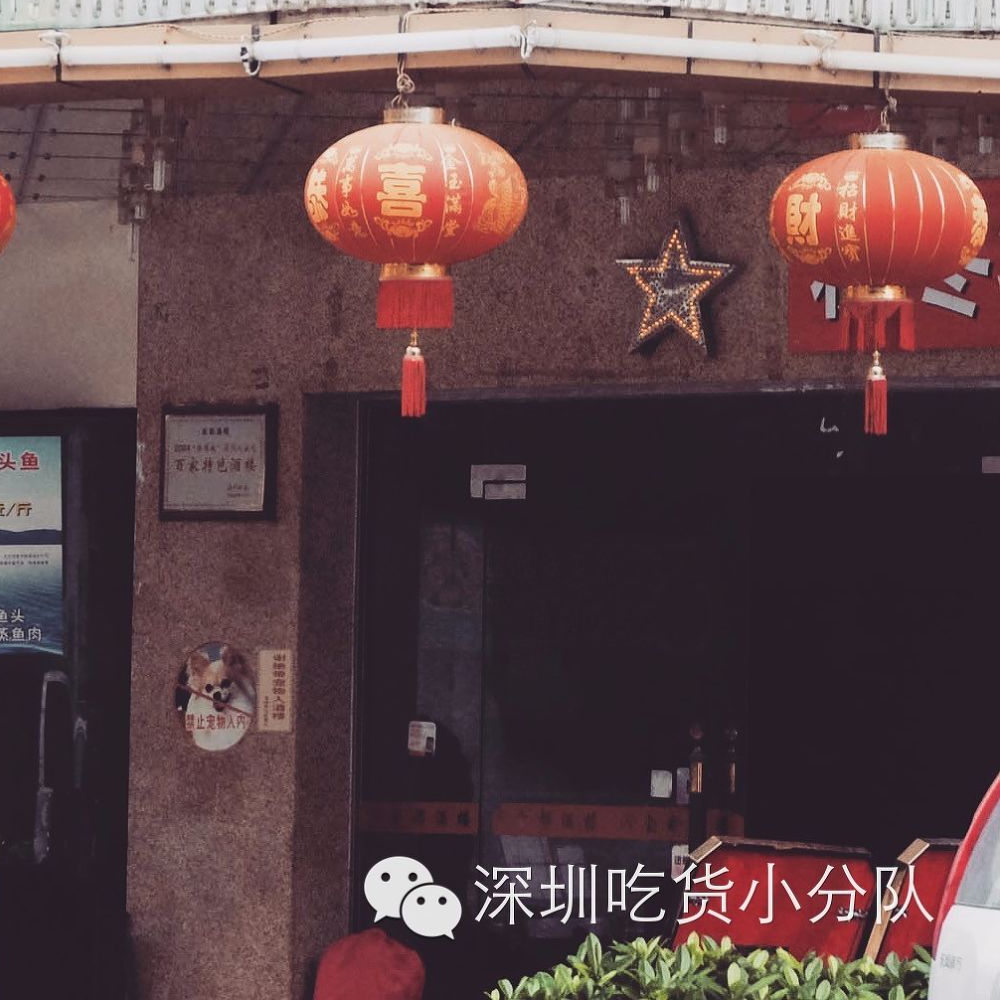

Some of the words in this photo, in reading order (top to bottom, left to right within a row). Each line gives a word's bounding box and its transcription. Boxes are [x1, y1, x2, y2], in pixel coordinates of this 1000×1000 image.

[186, 714, 247, 730] 禁止宠物入内
